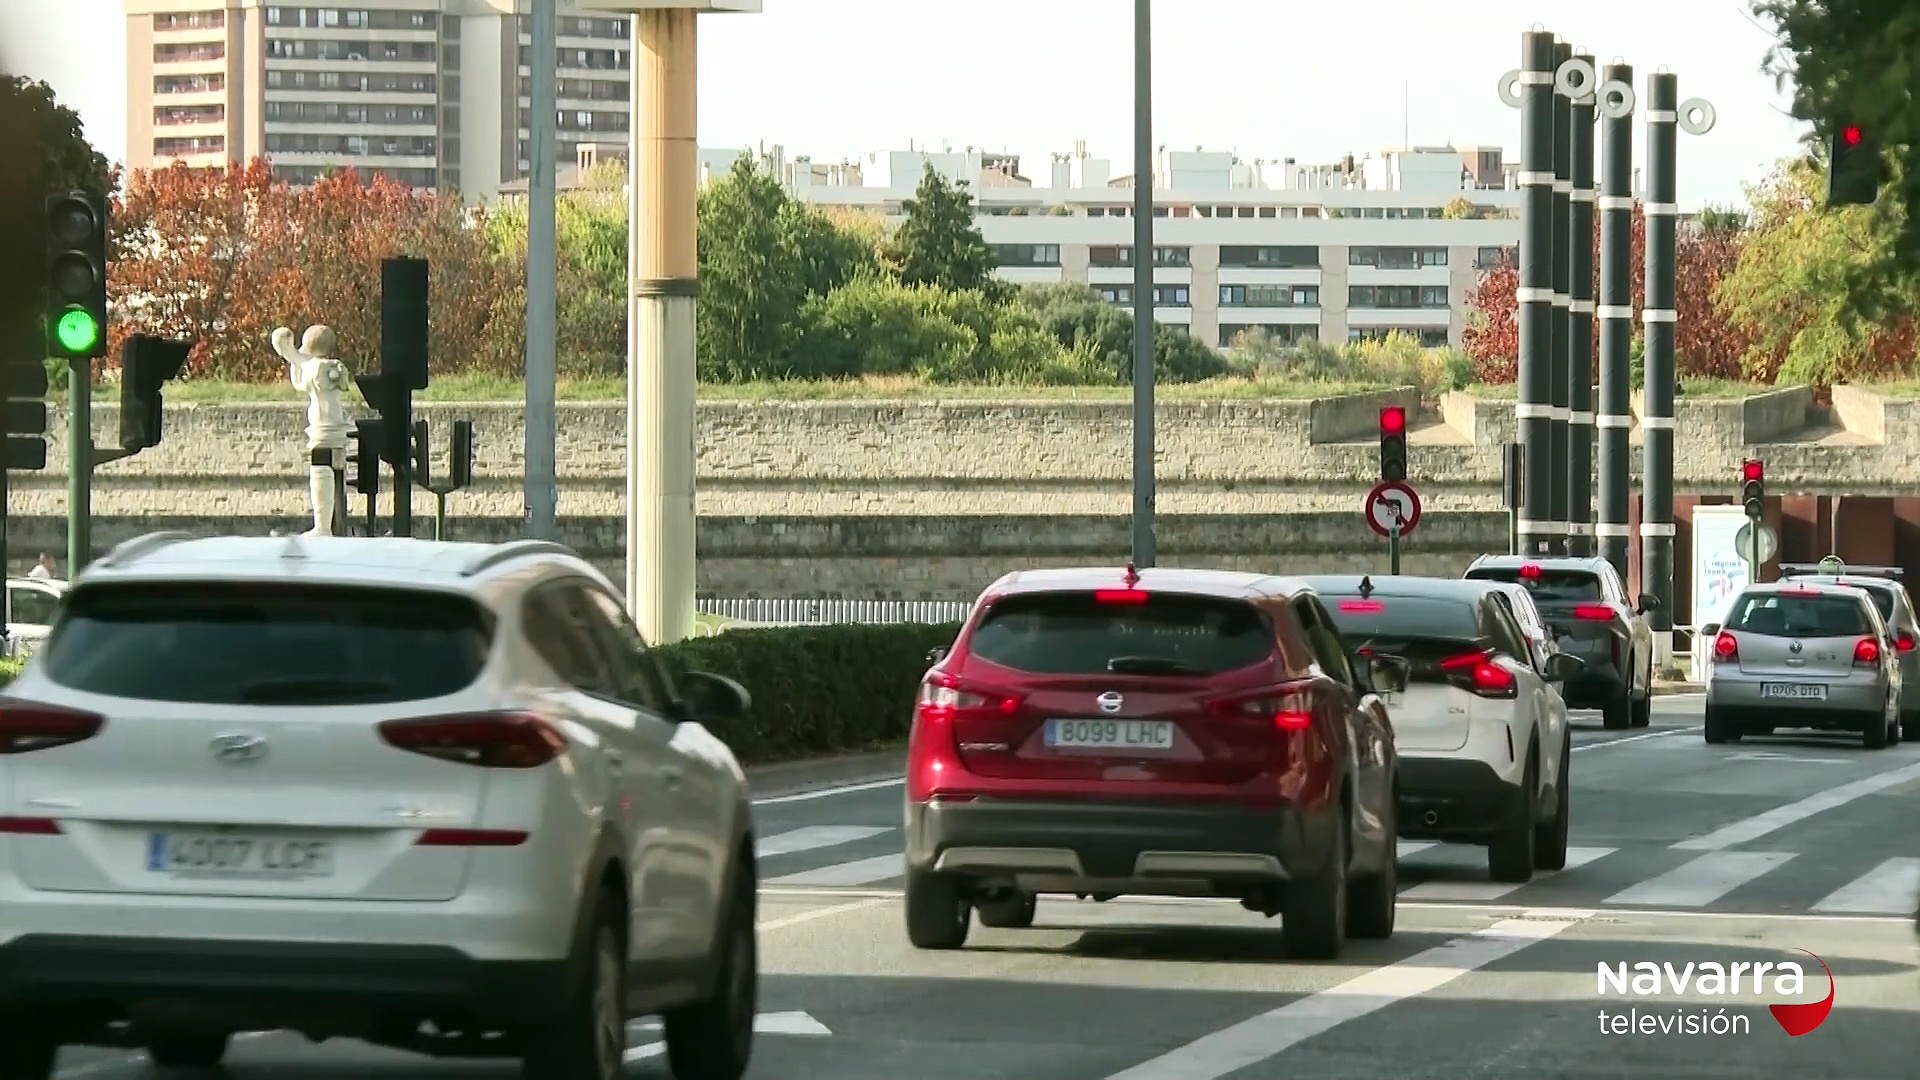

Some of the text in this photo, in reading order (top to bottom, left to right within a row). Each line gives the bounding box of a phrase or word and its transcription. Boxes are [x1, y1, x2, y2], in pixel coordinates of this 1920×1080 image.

[1772, 685, 1798, 696] 0705
[1062, 722, 1168, 744] 8099 LHC
